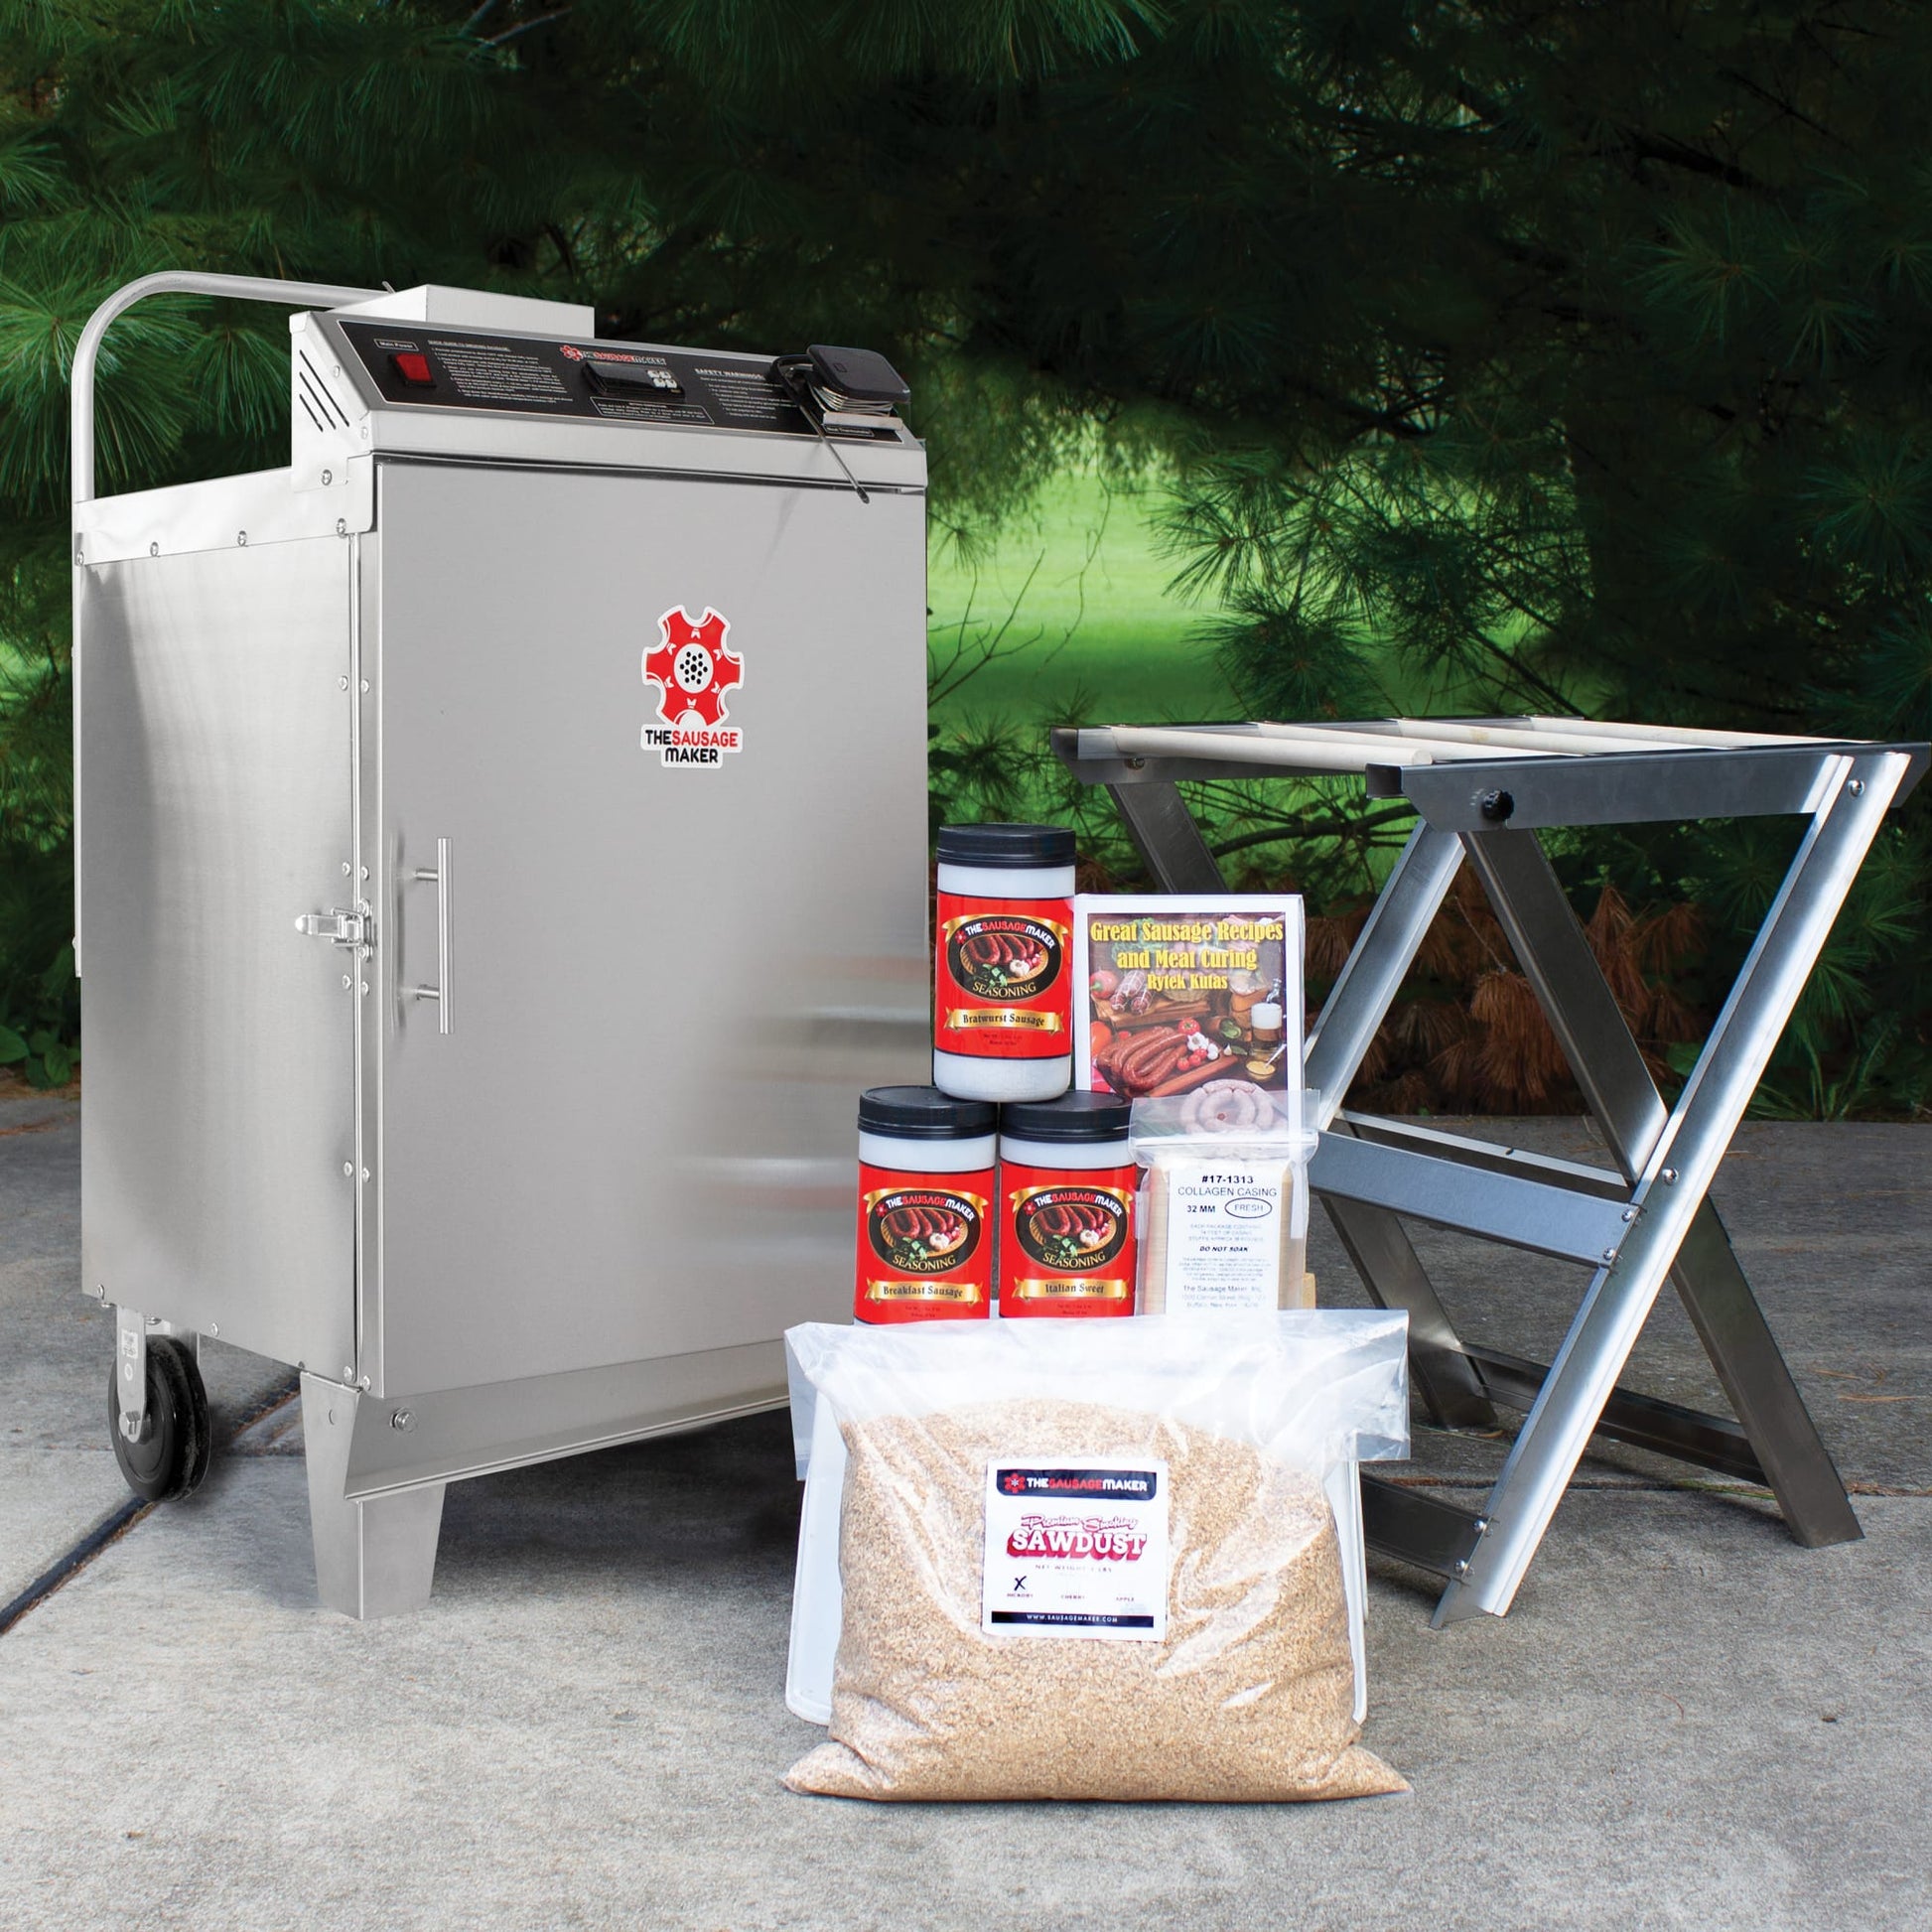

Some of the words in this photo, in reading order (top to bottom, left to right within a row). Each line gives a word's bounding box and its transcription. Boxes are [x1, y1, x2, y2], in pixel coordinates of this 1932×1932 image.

[695, 367, 723, 376] SAFETY
[664, 748, 719, 763] MAKER
[1090, 922, 1138, 941] Great
[1142, 921, 1212, 943] Sausage
[1216, 921, 1284, 943] Recipes
[1117, 950, 1151, 969] and
[1155, 950, 1195, 968] Meat
[1200, 949, 1258, 970] Curing
[1147, 973, 1185, 990] Rytek
[1189, 973, 1228, 990] Kutas
[972, 981, 1036, 999] SEASONING
[962, 1013, 1007, 1025] Bratwurst
[1009, 1014, 1045, 1027] Sausage
[1201, 1174, 1254, 1184] #17-1313
[1177, 1186, 1234, 1197] COLLAGEN
[1237, 1187, 1278, 1197] CASING
[1186, 1204, 1197, 1213] 32
[1199, 1204, 1216, 1213] MM
[1234, 1203, 1264, 1212] FRESH
[892, 1253, 957, 1272] SEASONING
[1042, 1251, 1106, 1269] SEASONING
[883, 1285, 925, 1297] Breakfast
[927, 1286, 963, 1298] Sausage
[1044, 1282, 1077, 1294] Italian
[1078, 1283, 1104, 1294] Sweet
[1007, 1529, 1148, 1561] SAWDUST
[1027, 1613, 1118, 1623] WWW.SAUSAGEMAKER.COM
